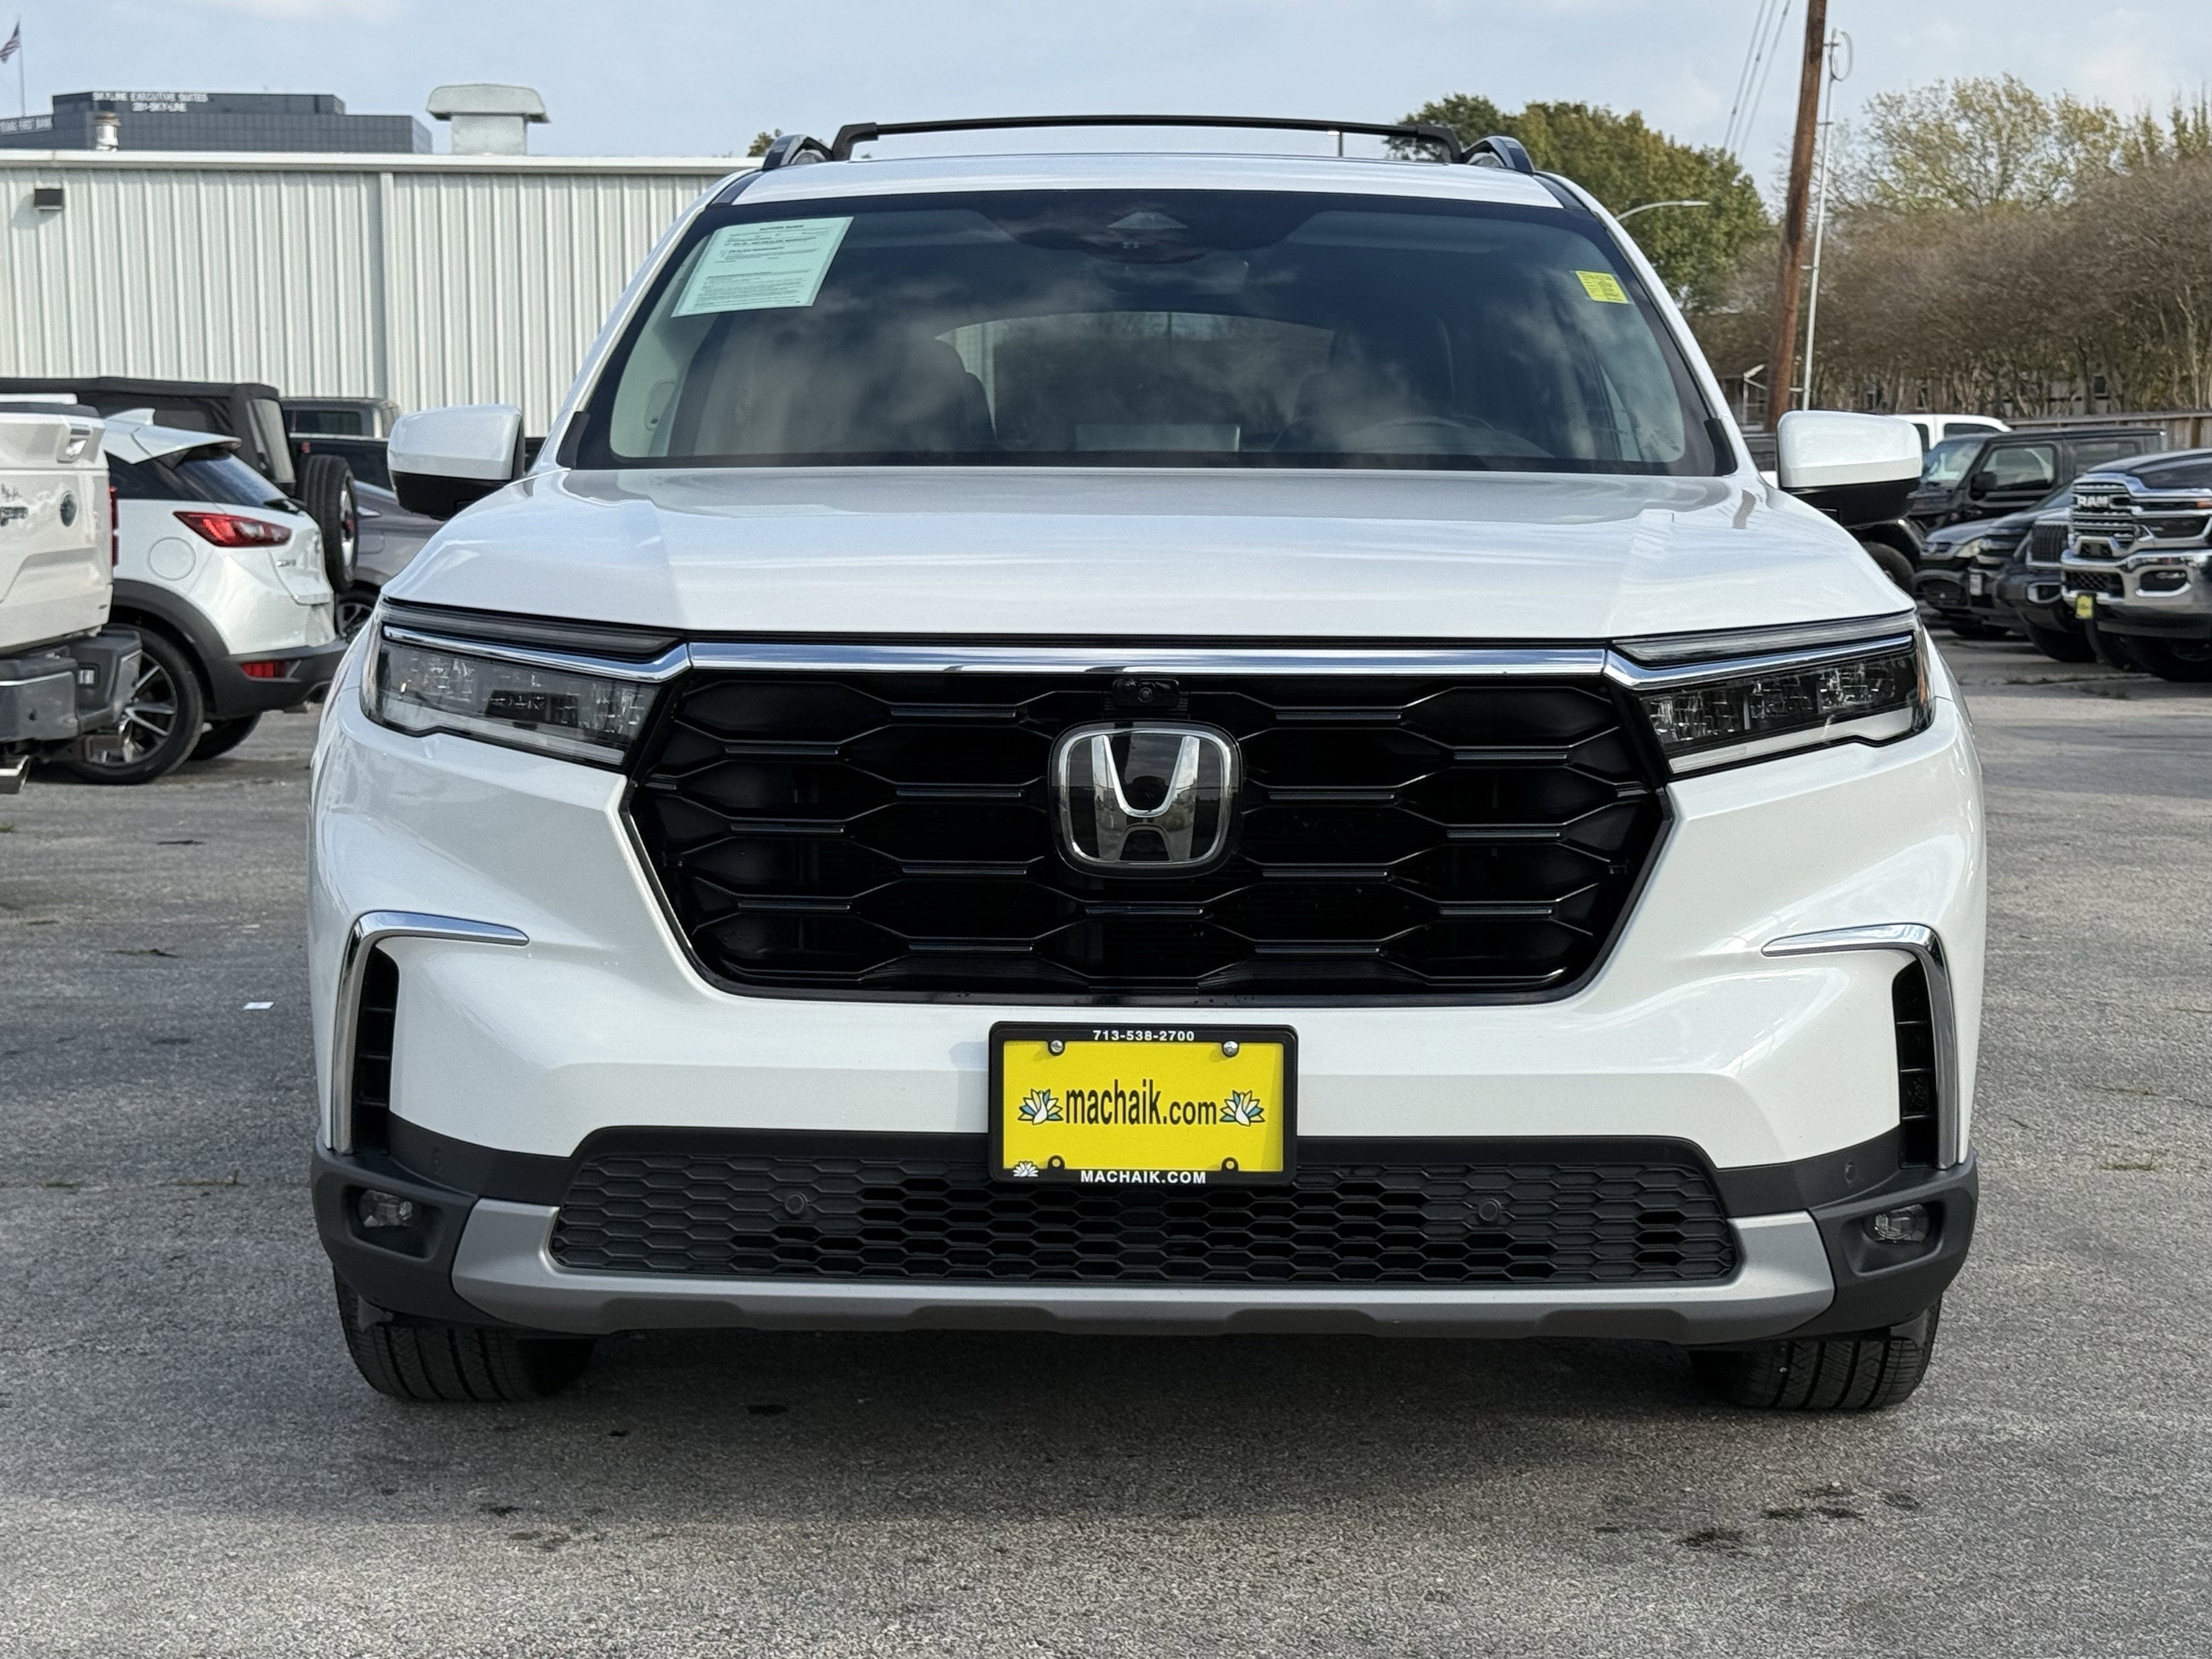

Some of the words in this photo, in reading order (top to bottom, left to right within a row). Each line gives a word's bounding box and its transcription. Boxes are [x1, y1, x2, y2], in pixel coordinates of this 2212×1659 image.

[177, 93, 208, 103] SUITES
[2077, 495, 2109, 508] RAM
[1093, 1030, 1195, 1041] 713-538-2700
[1065, 1078, 1217, 1125] machaik.com
[1080, 1170, 1206, 1184] MACHAIK.COM
